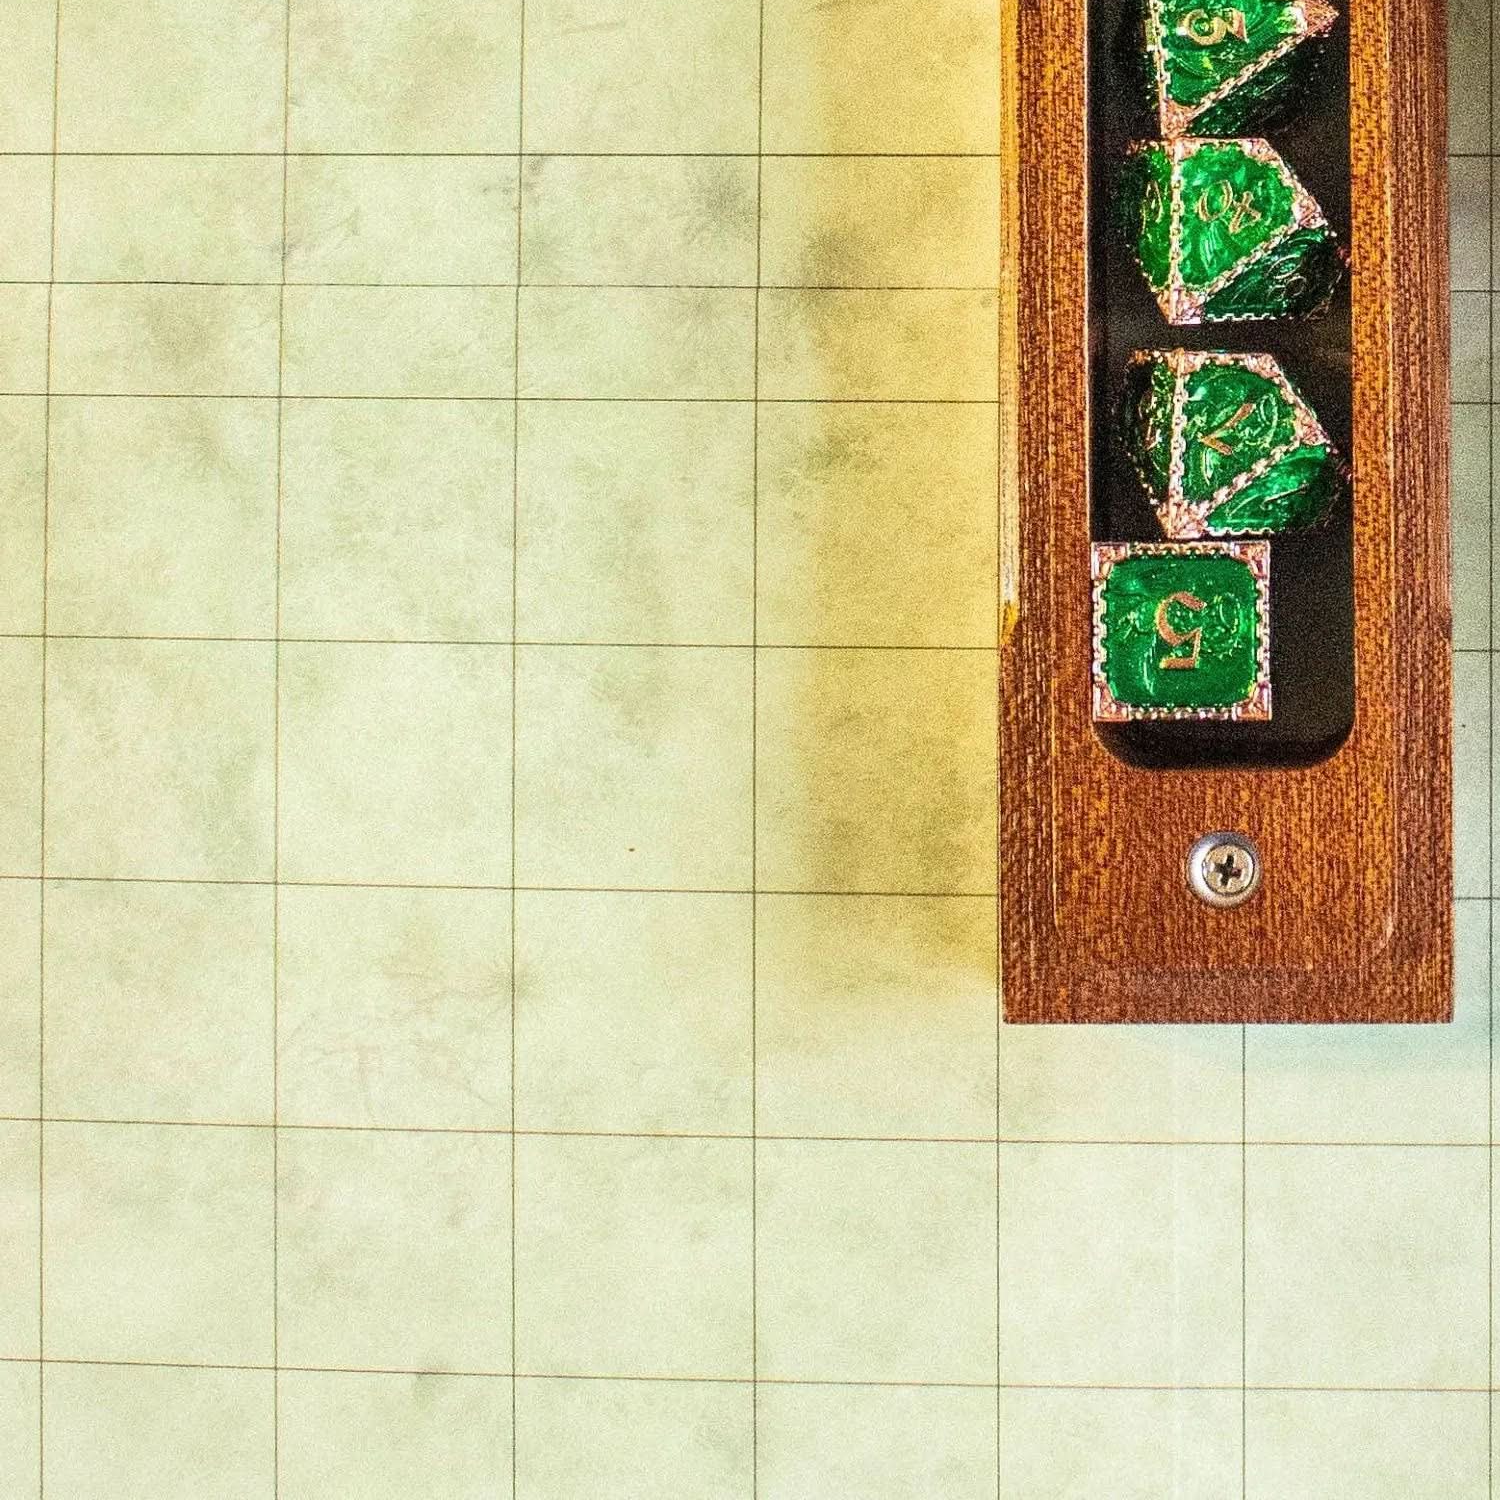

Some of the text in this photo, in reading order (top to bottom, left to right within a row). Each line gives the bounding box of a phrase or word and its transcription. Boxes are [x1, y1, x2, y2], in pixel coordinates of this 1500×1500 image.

[1195, 179, 1262, 235] 40
[1198, 402, 1257, 455] 7
[1155, 591, 1208, 669] 5
